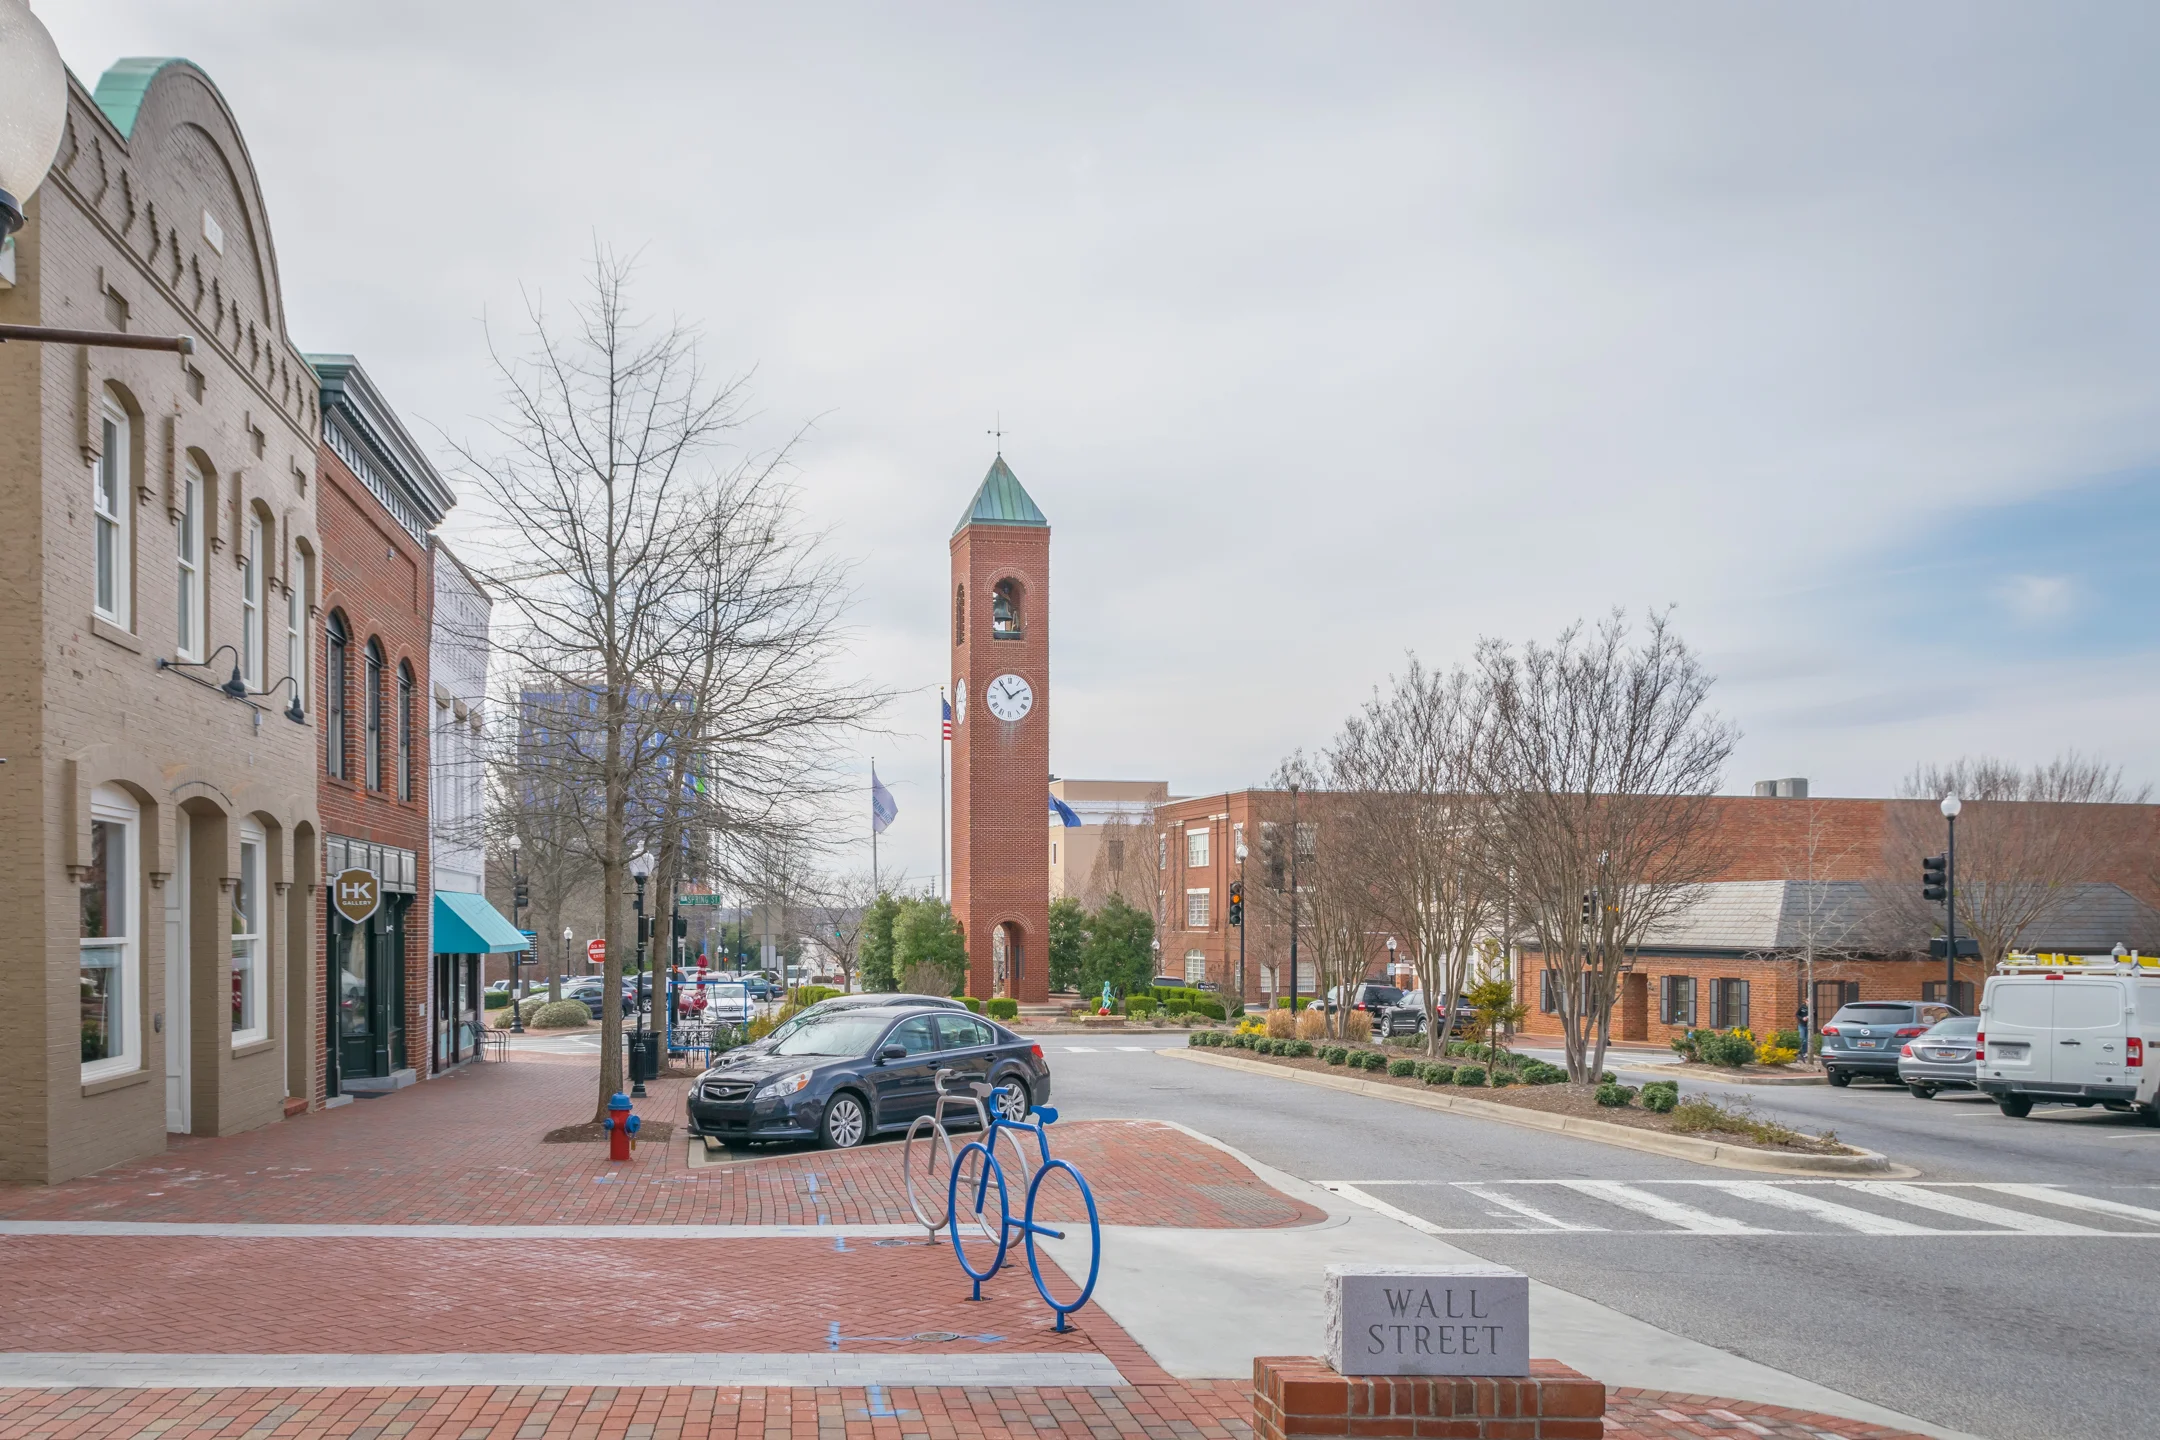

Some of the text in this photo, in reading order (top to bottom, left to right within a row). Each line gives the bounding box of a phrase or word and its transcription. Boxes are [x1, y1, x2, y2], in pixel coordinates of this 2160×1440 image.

[341, 882, 372, 899] HK
[688, 896, 710, 904] SPRING
[1382, 1288, 1489, 1319] WALL
[1367, 1323, 1504, 1355] STREET
